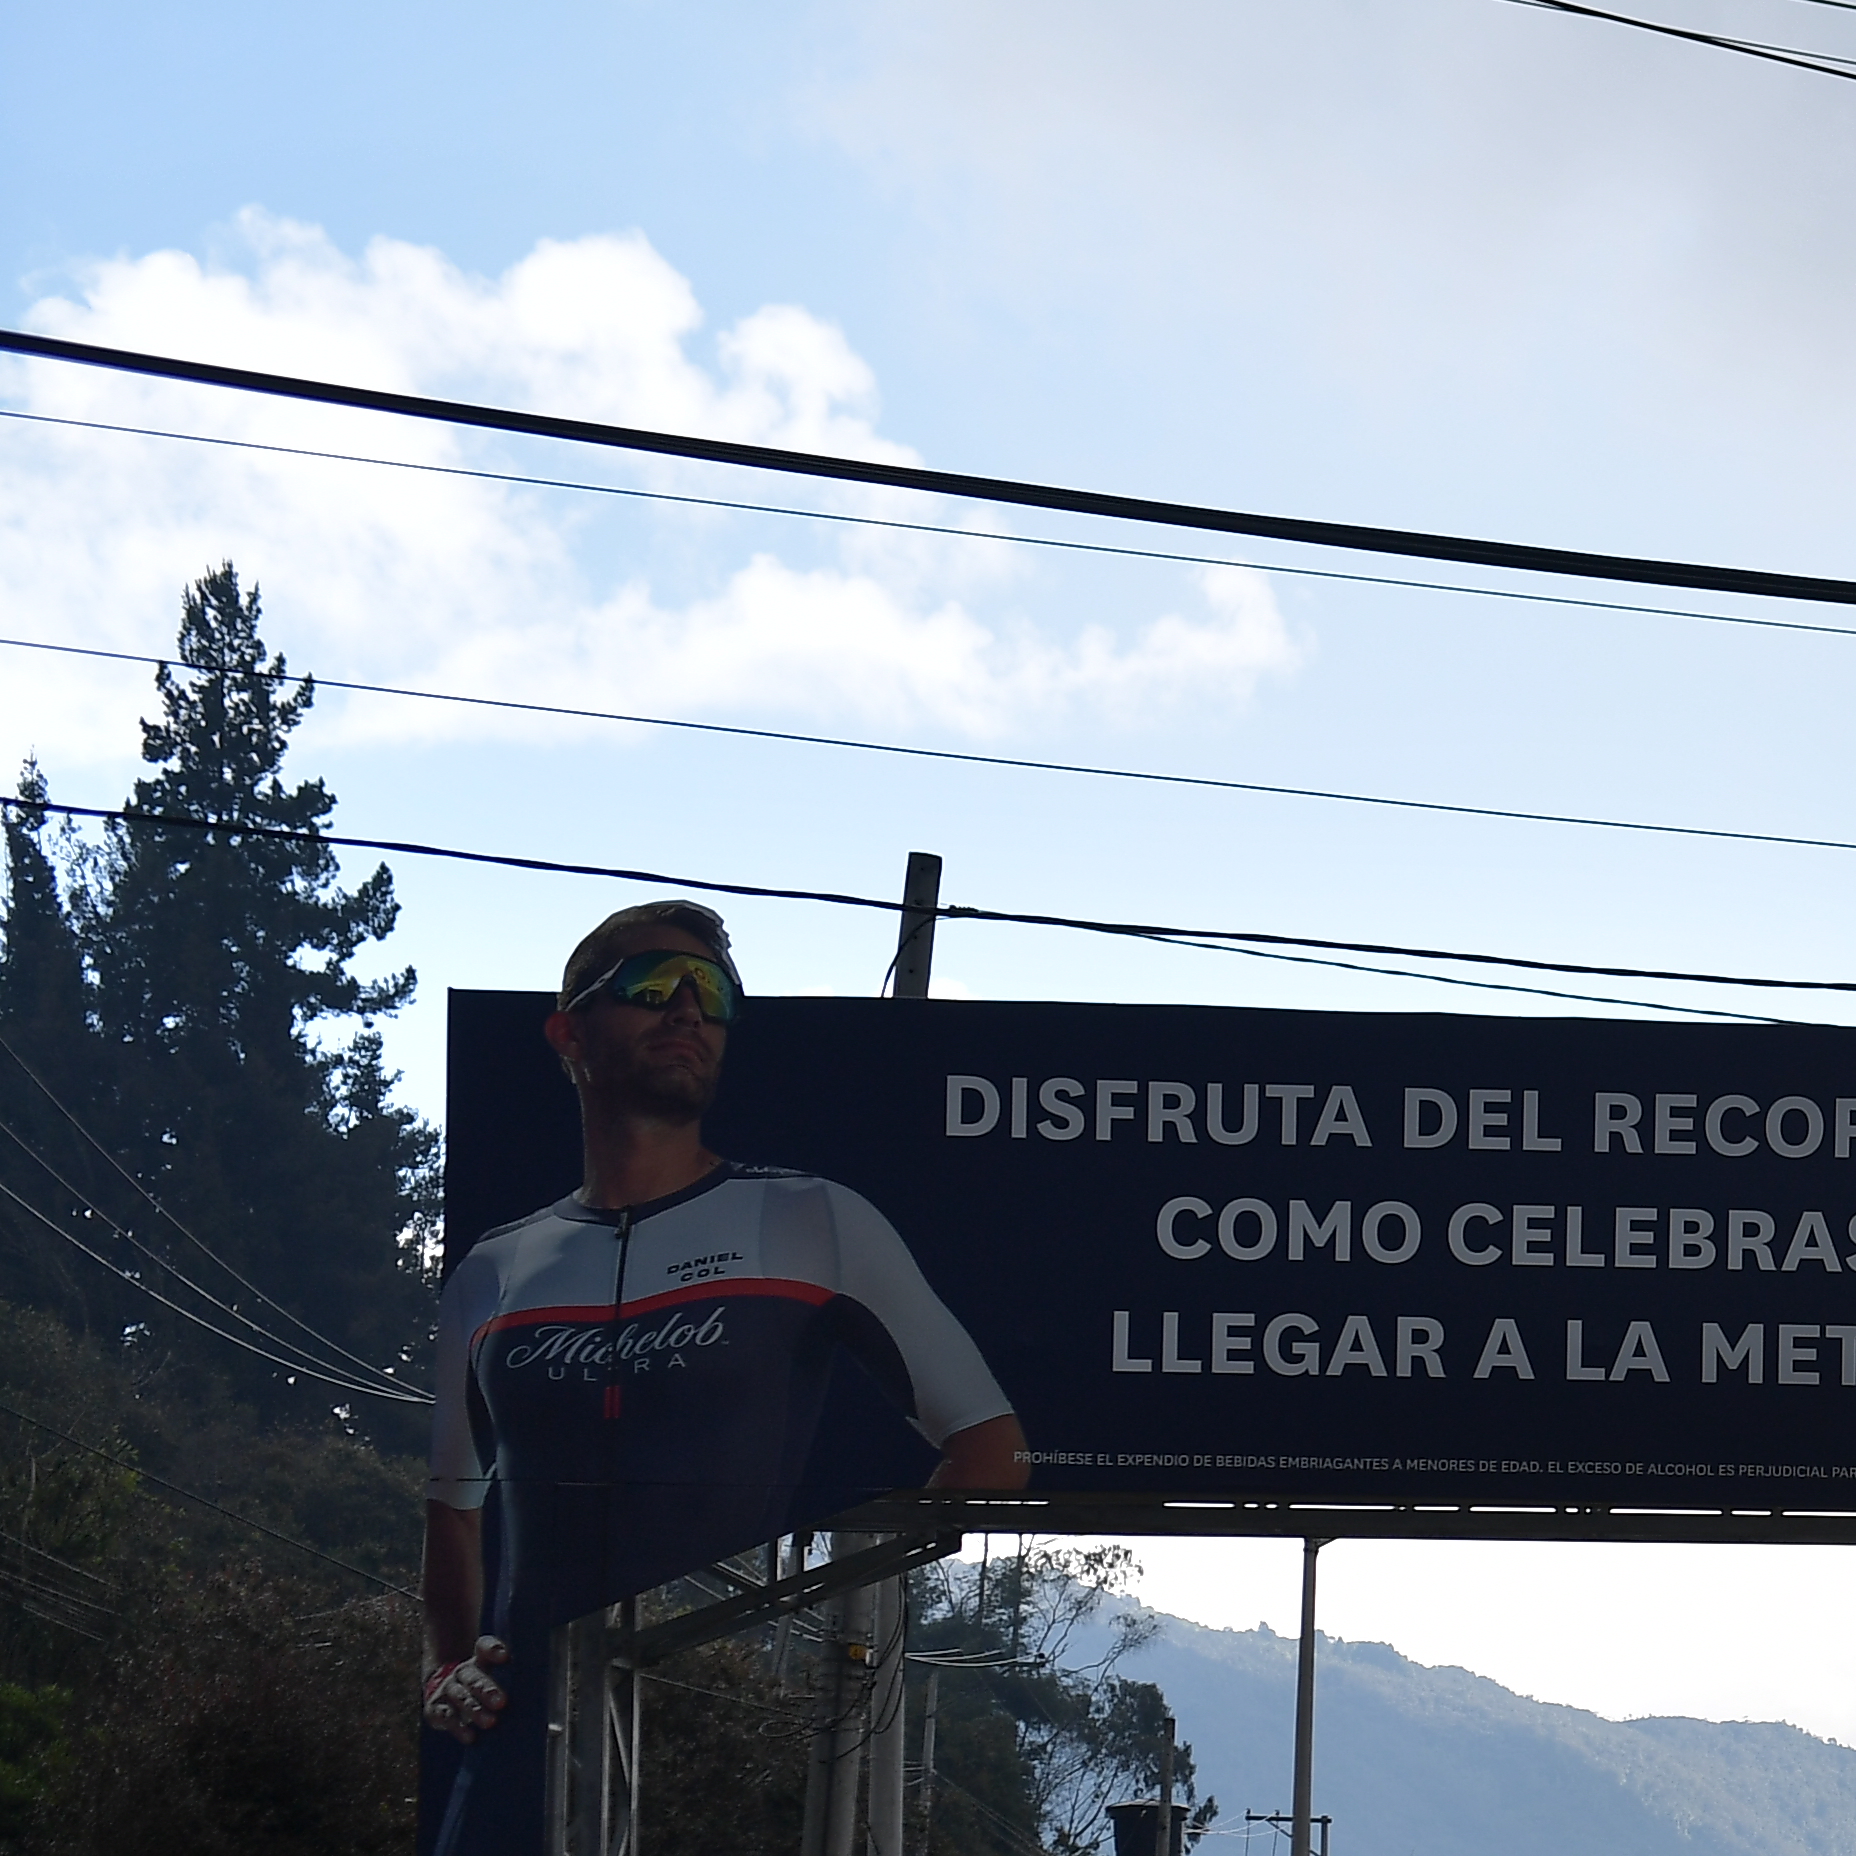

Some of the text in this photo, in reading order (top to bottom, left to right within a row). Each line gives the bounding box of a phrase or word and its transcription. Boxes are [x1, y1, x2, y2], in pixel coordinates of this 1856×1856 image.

[944, 1074, 1373, 1149] DISFRUTA
[1402, 1087, 1563, 1153] DEL
[1155, 1195, 1422, 1265] COMO
[667, 1252, 744, 1275] DANIEL
[680, 1267, 726, 1282] COL
[505, 1305, 726, 1369] Michelob
[1111, 1310, 1447, 1380] LLEGAR
[1473, 1317, 1536, 1381] A
[1565, 1319, 1671, 1384] LA
[547, 1352, 687, 1382] ULRA
[1013, 1449, 1093, 1466] PROHÍBESE
[1097, 1453, 1114, 1467] EL
[1117, 1454, 1190, 1468] EXPENDIO
[1193, 1455, 1212, 1469] DE
[1215, 1456, 1276, 1469] BEBIDAS
[1279, 1457, 1390, 1471] EMBRIAGANTES
[1392, 1458, 1403, 1472] A
[1406, 1459, 1475, 1473] MENORES
[1479, 1460, 1498, 1474] DE
[1501, 1460, 1543, 1474] EDAD.
[1548, 1461, 1564, 1475] EL
[1567, 1462, 1621, 1475] EXCESO
[1625, 1462, 1644, 1476] DE
[1647, 1463, 1714, 1477] ALCOHOL
[1718, 1464, 1735, 1478] ES
[1738, 1465, 1828, 1479] PERJUDICIAL
